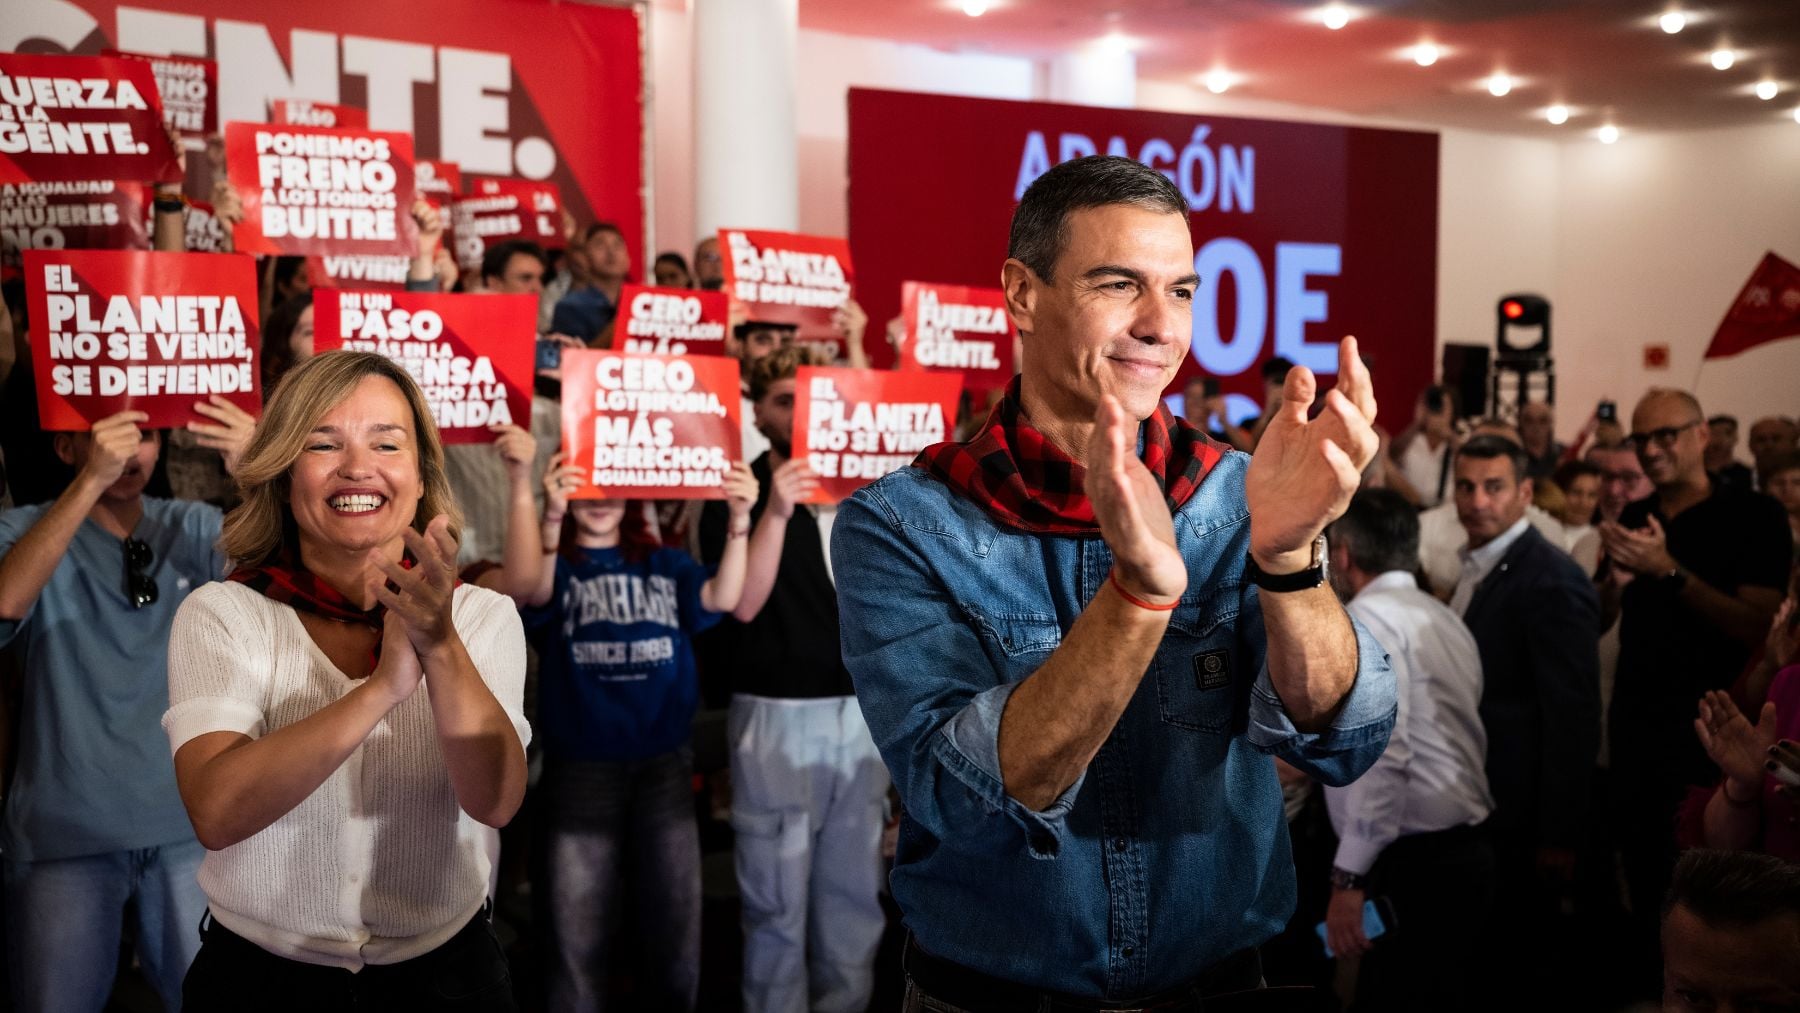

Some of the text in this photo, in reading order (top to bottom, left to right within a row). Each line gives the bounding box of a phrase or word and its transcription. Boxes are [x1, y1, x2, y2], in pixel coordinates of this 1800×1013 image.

[0, 76, 148, 110] UERZA
[0, 121, 150, 155] GENTE.
[255, 131, 391, 161] PONEMOS
[258, 155, 397, 193] FRENO
[261, 188, 397, 209] A LOS FONDOS
[0, 203, 119, 227] MUJERES
[262, 205, 397, 240] BUITRE
[44, 264, 79, 292] EL
[47, 294, 245, 333] PLANETA
[1188, 236, 1341, 377] OE
[340, 309, 443, 341] PASO
[50, 332, 254, 362] NO SE VENDE,
[51, 362, 254, 396] SE DEFIENDE
[595, 356, 696, 393] CERO
[810, 377, 839, 400] EL
[595, 410, 675, 449] MÁS
[809, 400, 945, 433] PLANETA
[807, 429, 850, 452] NO
[850, 430, 880, 453] SE
[593, 446, 732, 473] DERECHOS,
[571, 640, 627, 664] SINCE
